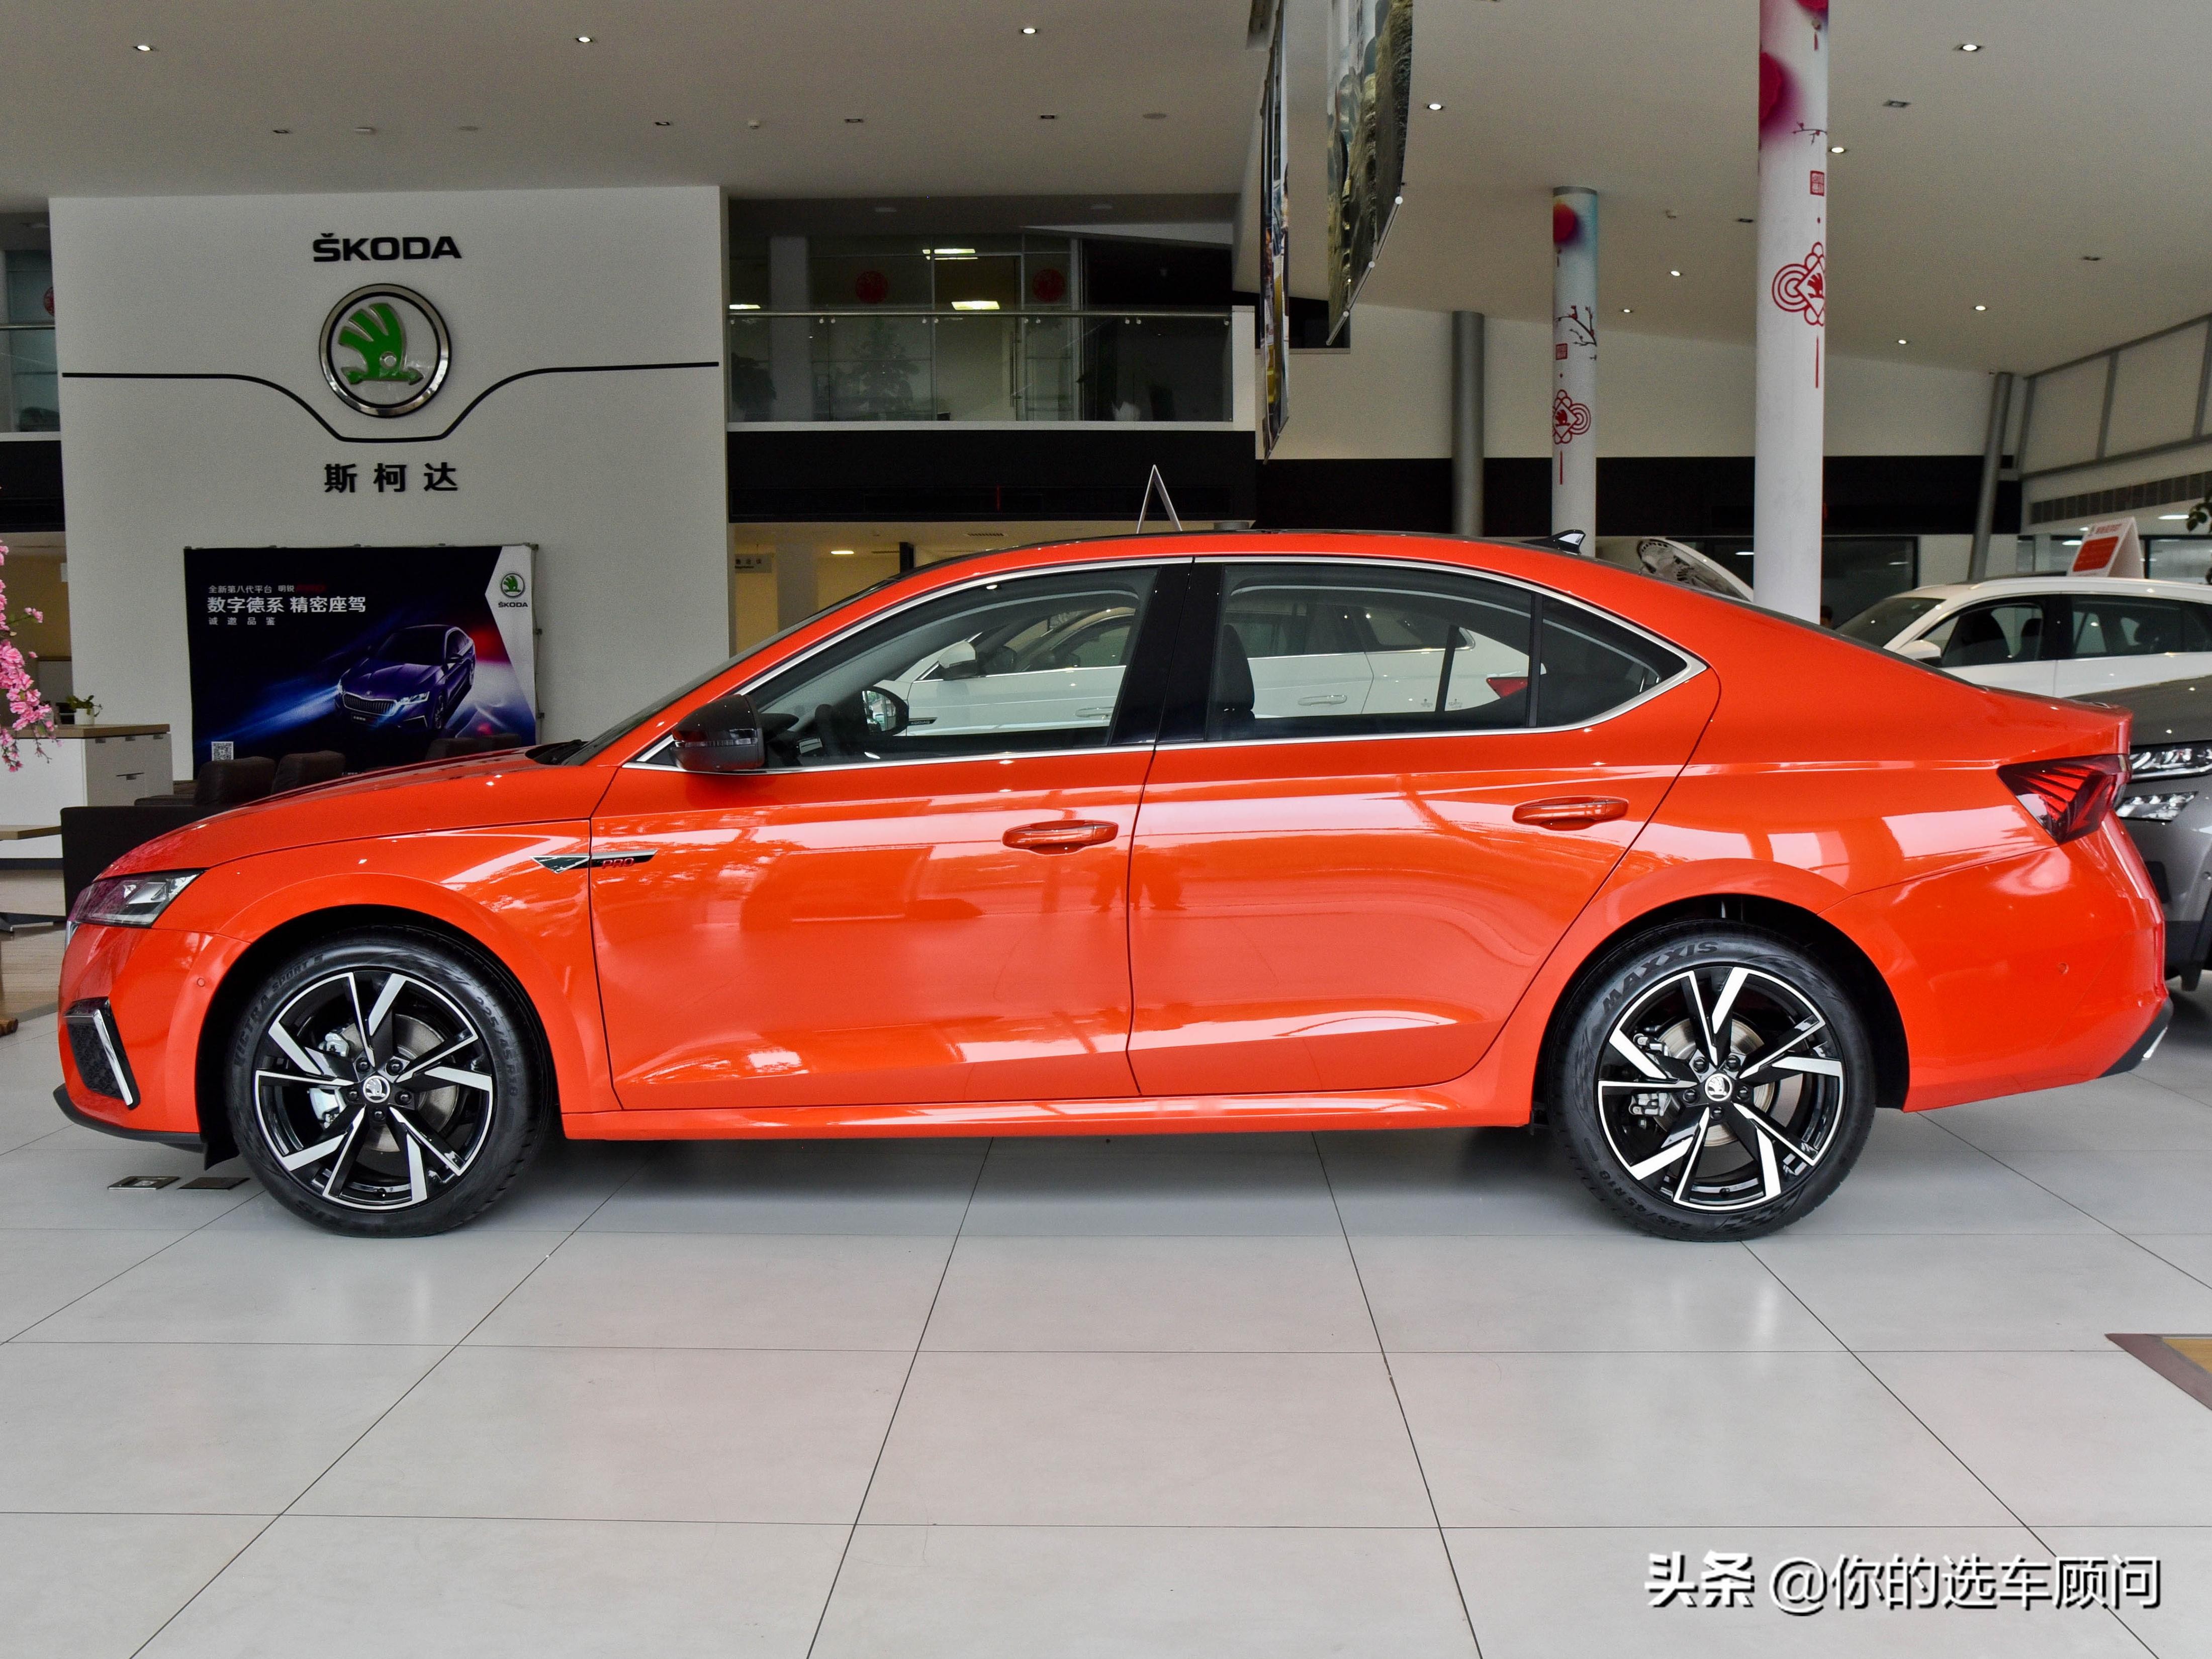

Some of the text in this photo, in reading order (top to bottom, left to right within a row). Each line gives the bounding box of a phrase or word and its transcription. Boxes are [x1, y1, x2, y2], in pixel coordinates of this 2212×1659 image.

[313, 233, 462, 262] ŠKODA
[324, 462, 458, 493] 斯柯达
[208, 585, 272, 594] 全新第八代平台
[278, 585, 296, 593] 明锐
[207, 596, 366, 613] 数字德系 精密座驾
[208, 617, 276, 626] 诚邀品鉴
[602, 857, 634, 869] PRO
[1603, 941, 1718, 1016] MAXXIS
